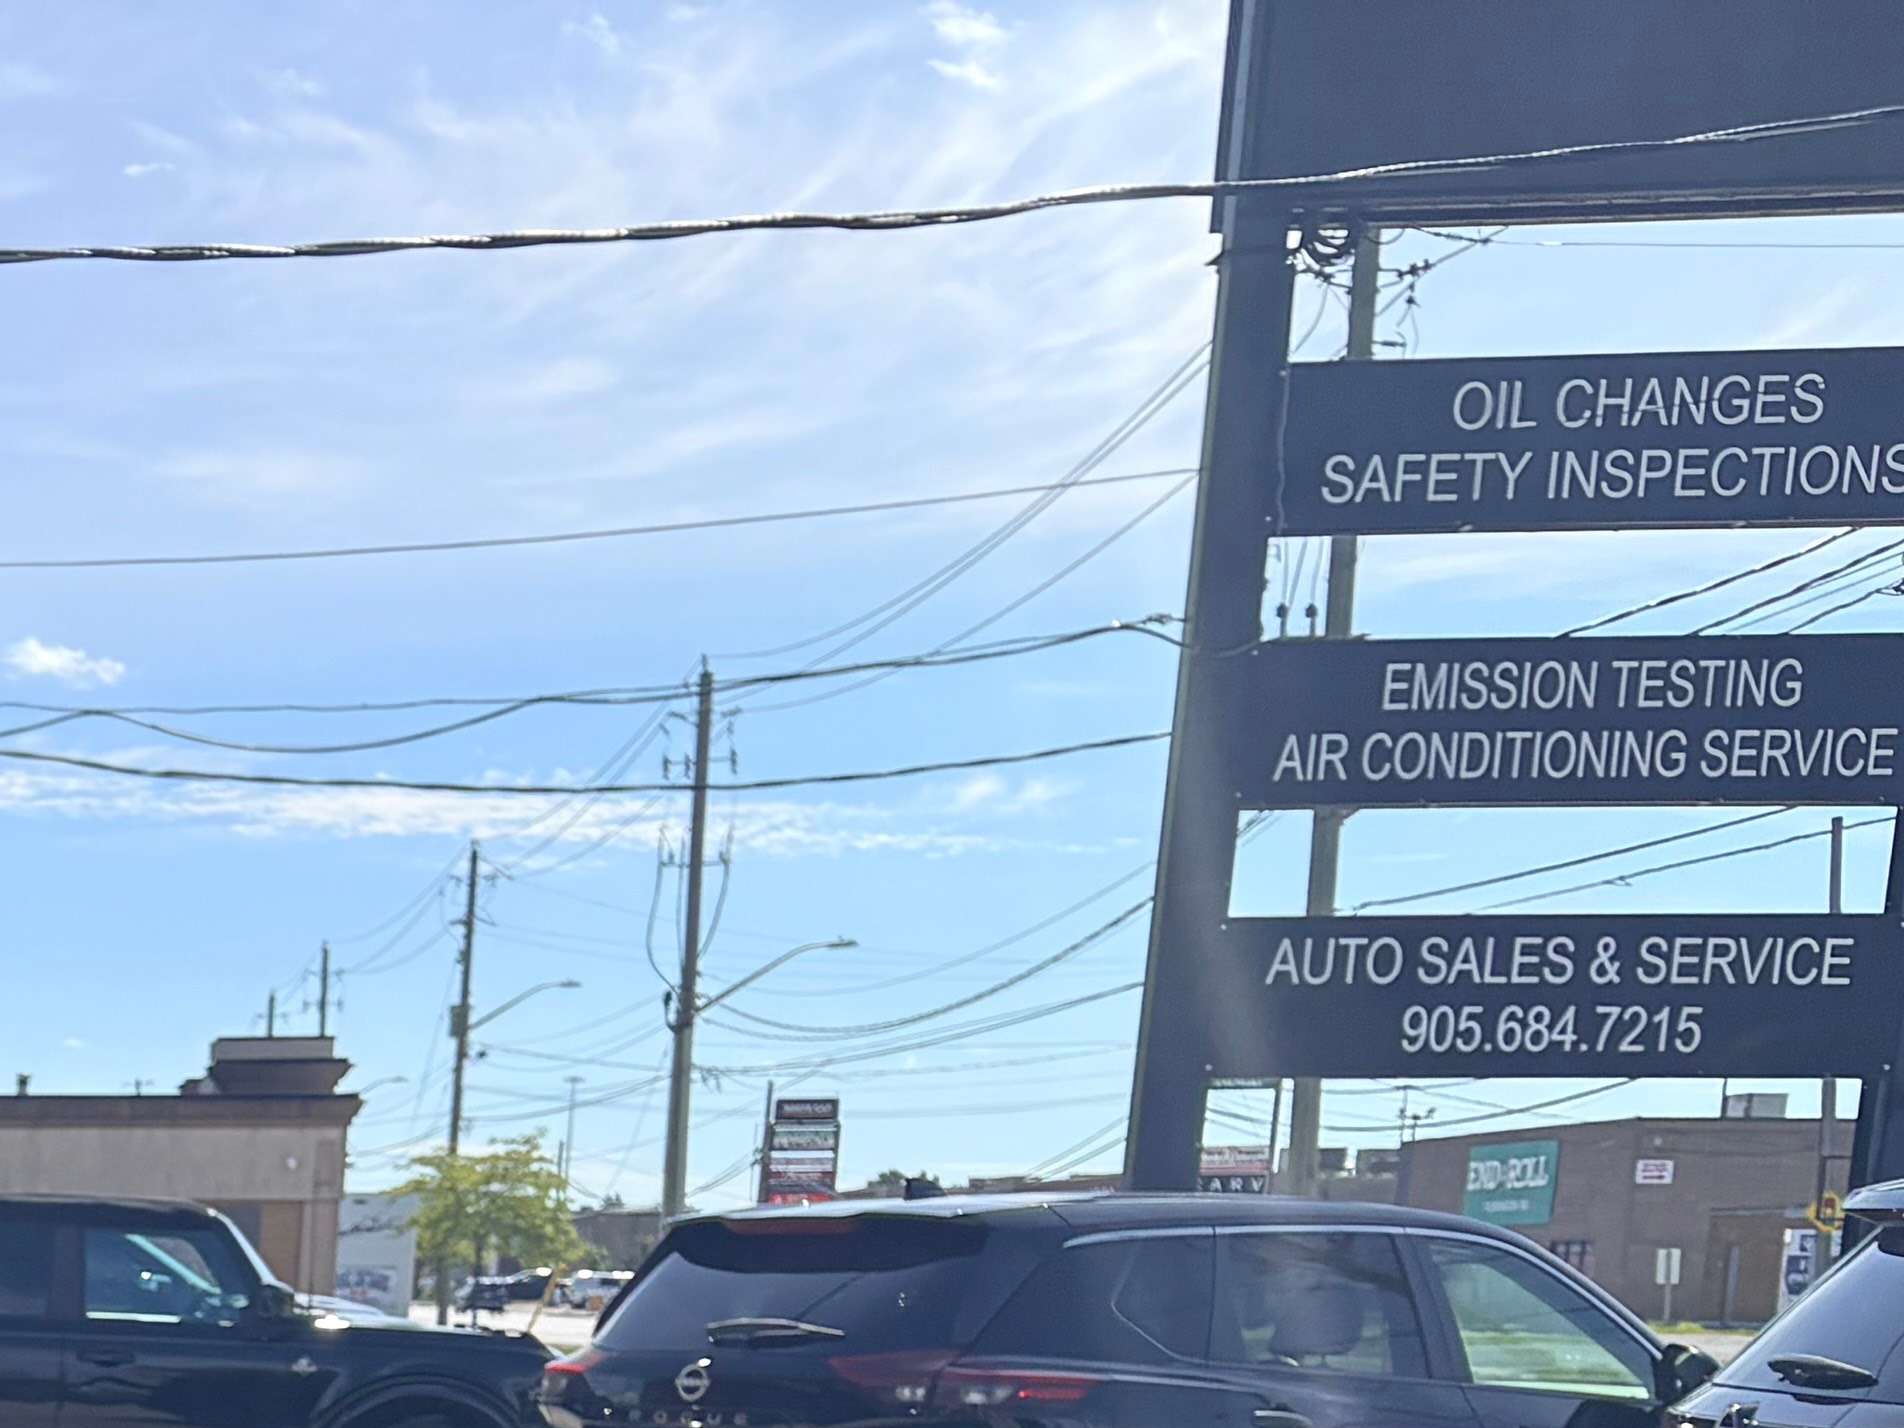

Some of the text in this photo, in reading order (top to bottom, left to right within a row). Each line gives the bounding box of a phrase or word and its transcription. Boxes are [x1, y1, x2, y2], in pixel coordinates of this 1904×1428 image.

[1453, 373, 1827, 431] OIL CHANGES
[1321, 443, 1904, 504] SAFETY INSPECTIONS
[1382, 658, 1804, 711] EMISSION TESTING
[1272, 727, 1899, 782] AIR CONDITIONING SERVICE
[1265, 936, 1855, 986] AUTO SALES & SERVICE
[1401, 1004, 1703, 1054] 905.684.7215
